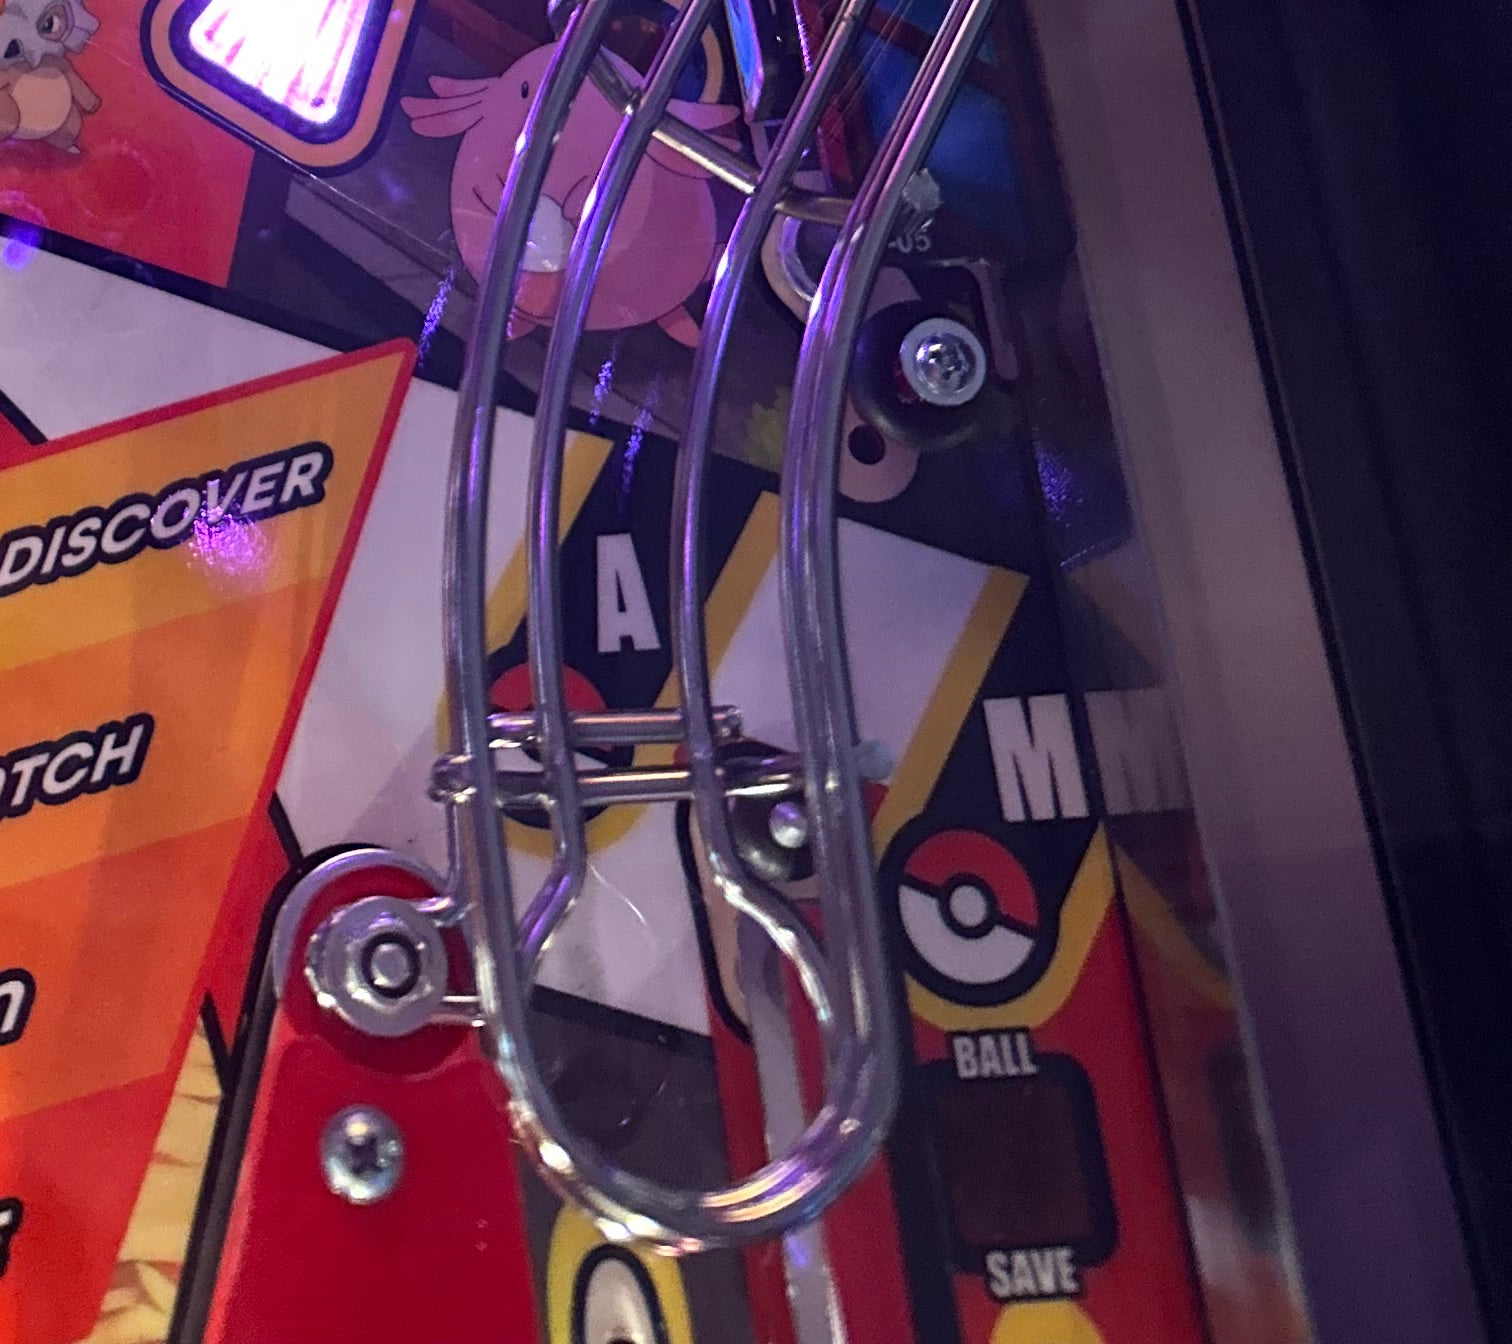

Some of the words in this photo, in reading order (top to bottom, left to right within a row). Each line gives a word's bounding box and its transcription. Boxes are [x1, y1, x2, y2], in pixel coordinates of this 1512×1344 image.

[594, 533, 661, 654] A
[982, 692, 1089, 823] M
[952, 1031, 1038, 1079] BALL
[986, 1248, 1080, 1298] SAVE
